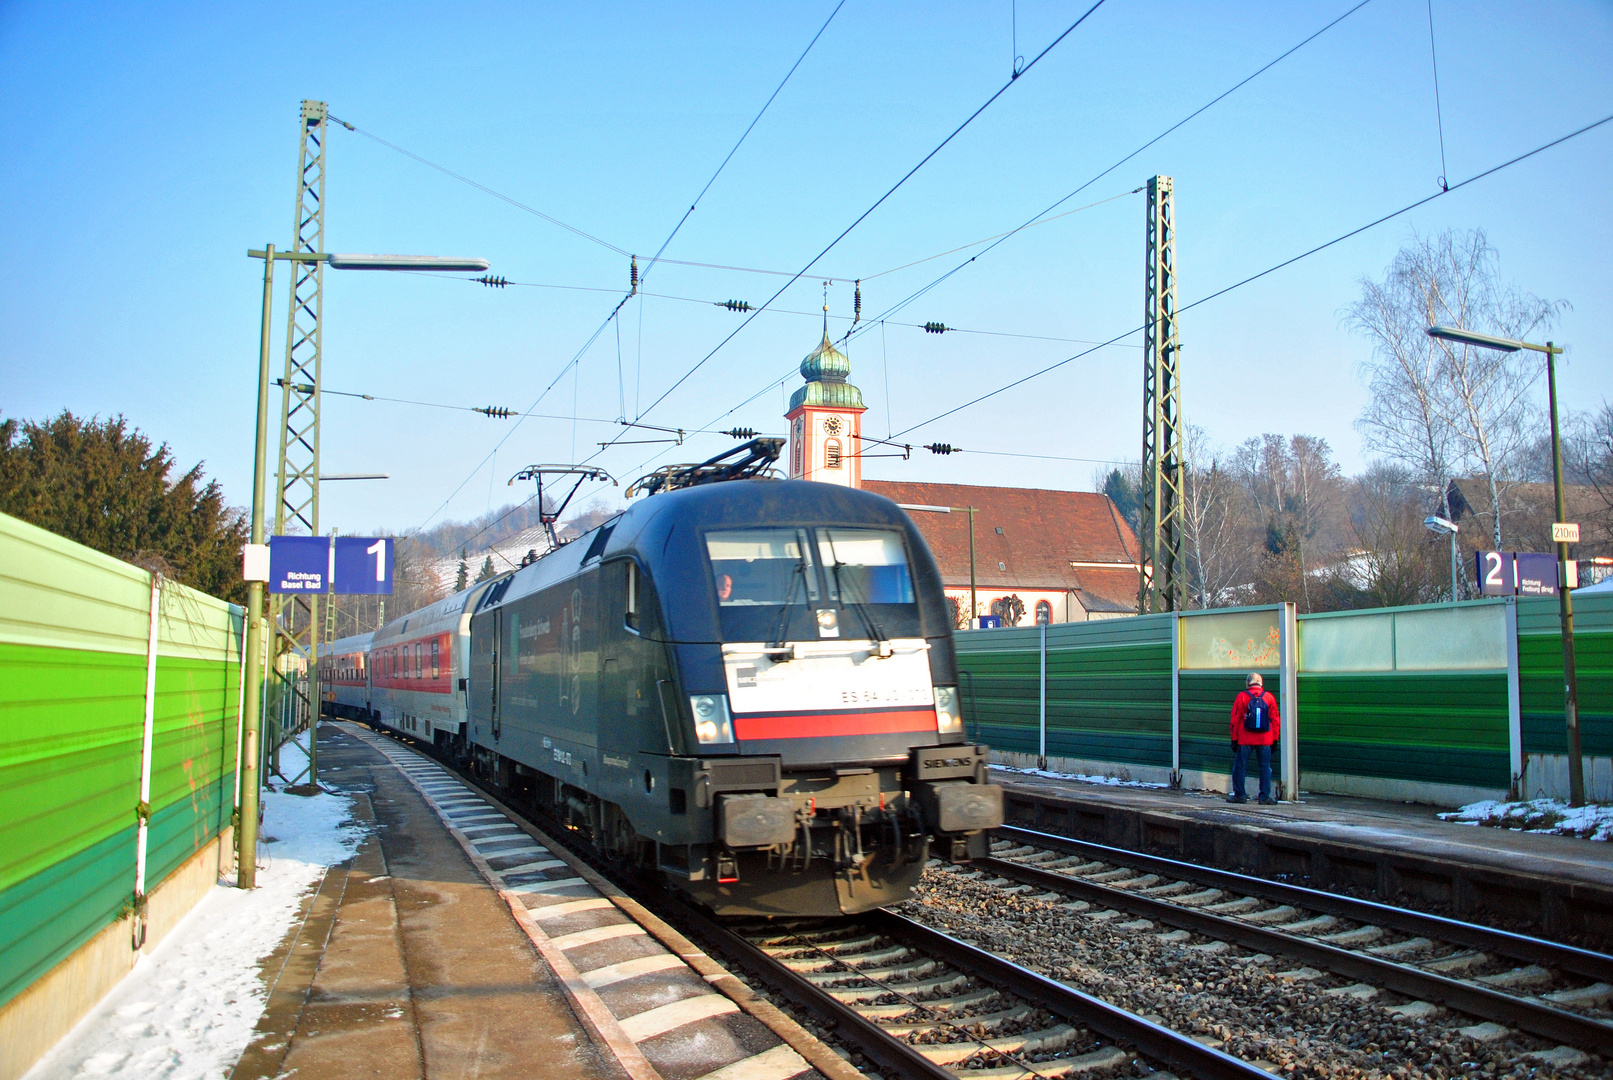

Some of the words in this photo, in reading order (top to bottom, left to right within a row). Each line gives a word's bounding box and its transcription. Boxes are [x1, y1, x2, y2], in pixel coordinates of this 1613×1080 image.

[1554, 527, 1578, 538] 210m
[367, 539, 386, 581] 1
[1485, 552, 1502, 585] 2
[287, 571, 321, 581] Richtung
[281, 580, 304, 589] Basel
[305, 580, 321, 589] Bad
[1521, 579, 1541, 587] Richtung
[923, 757, 972, 769] SIEMENS
